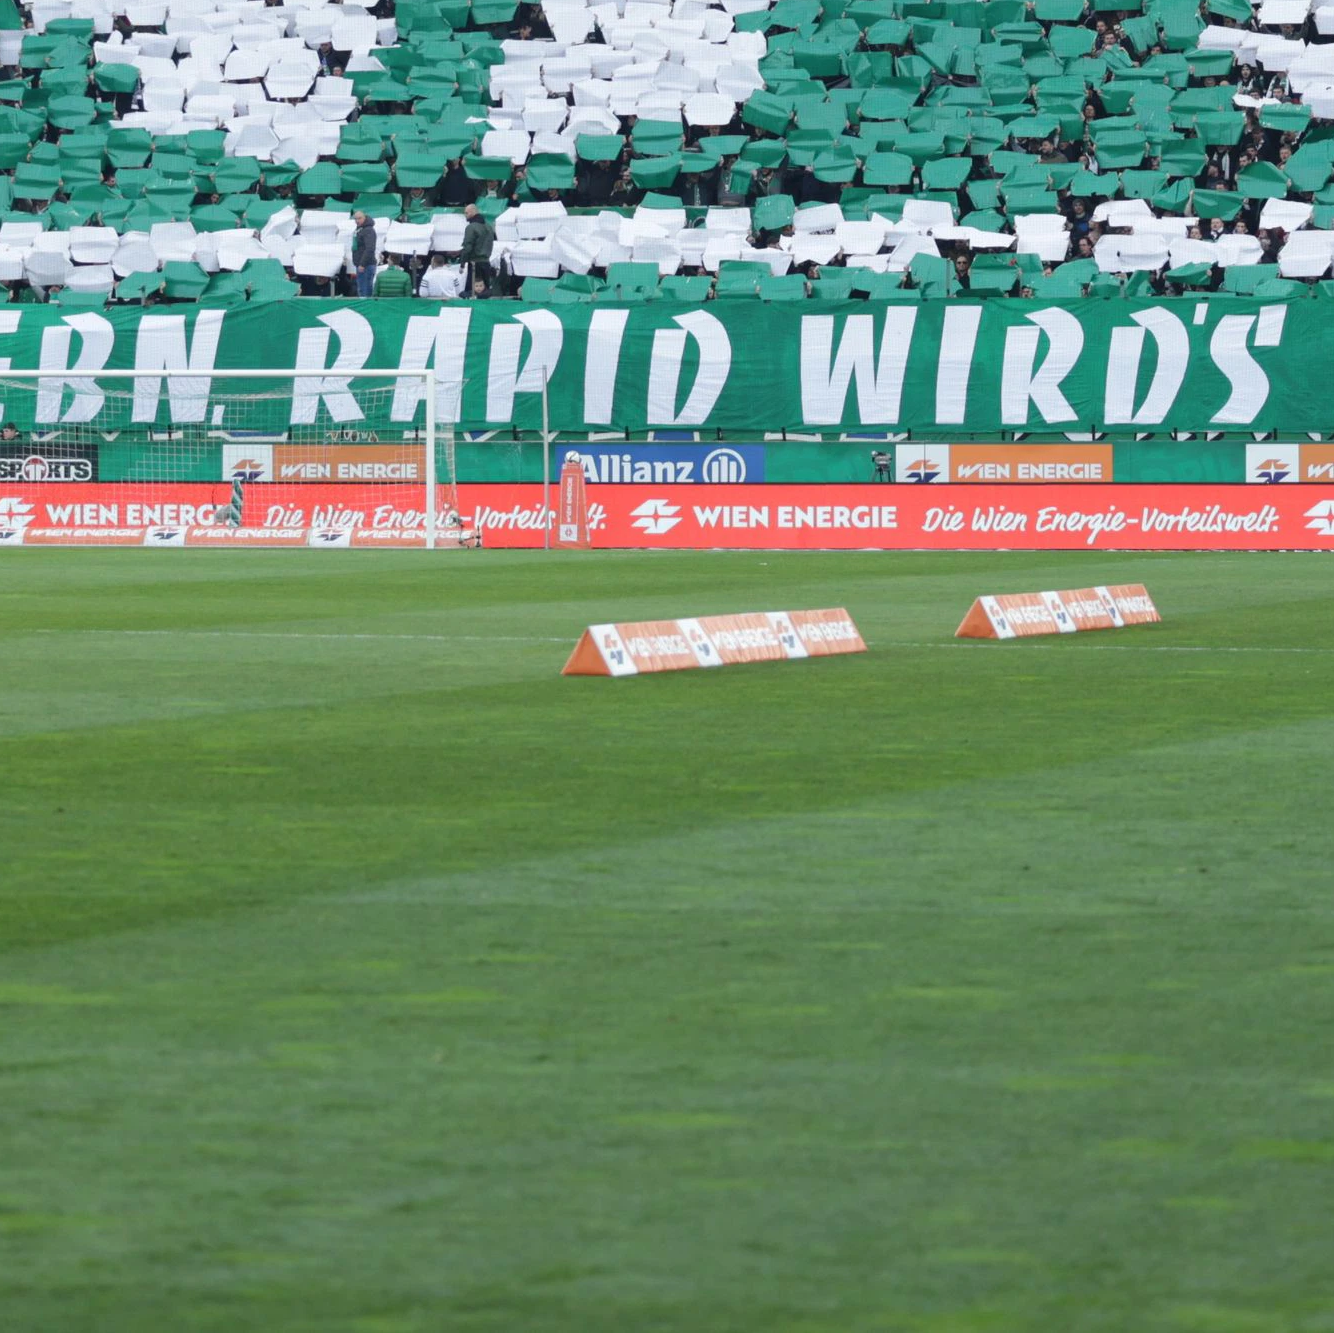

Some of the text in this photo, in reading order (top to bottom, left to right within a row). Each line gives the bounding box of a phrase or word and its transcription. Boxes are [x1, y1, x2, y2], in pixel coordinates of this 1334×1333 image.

[290, 305, 733, 427] RAPID
[799, 302, 1287, 426] WIRD'S
[280, 463, 418, 478] WIEN ENERGIE
[957, 463, 1102, 479] WIEN ENERGIE
[46, 504, 233, 527] WIEN ENERG
[263, 503, 305, 528] Die
[312, 504, 366, 529] Wien
[692, 505, 898, 528] WIEN ENERGIE
[922, 505, 1279, 545] Die Wien Energie-Vorteilswelt.
[31, 527, 144, 537] WIEN ENERGIE
[192, 528, 305, 538] WIEN ENERGIE
[402, 529, 473, 539] ENRGIE
